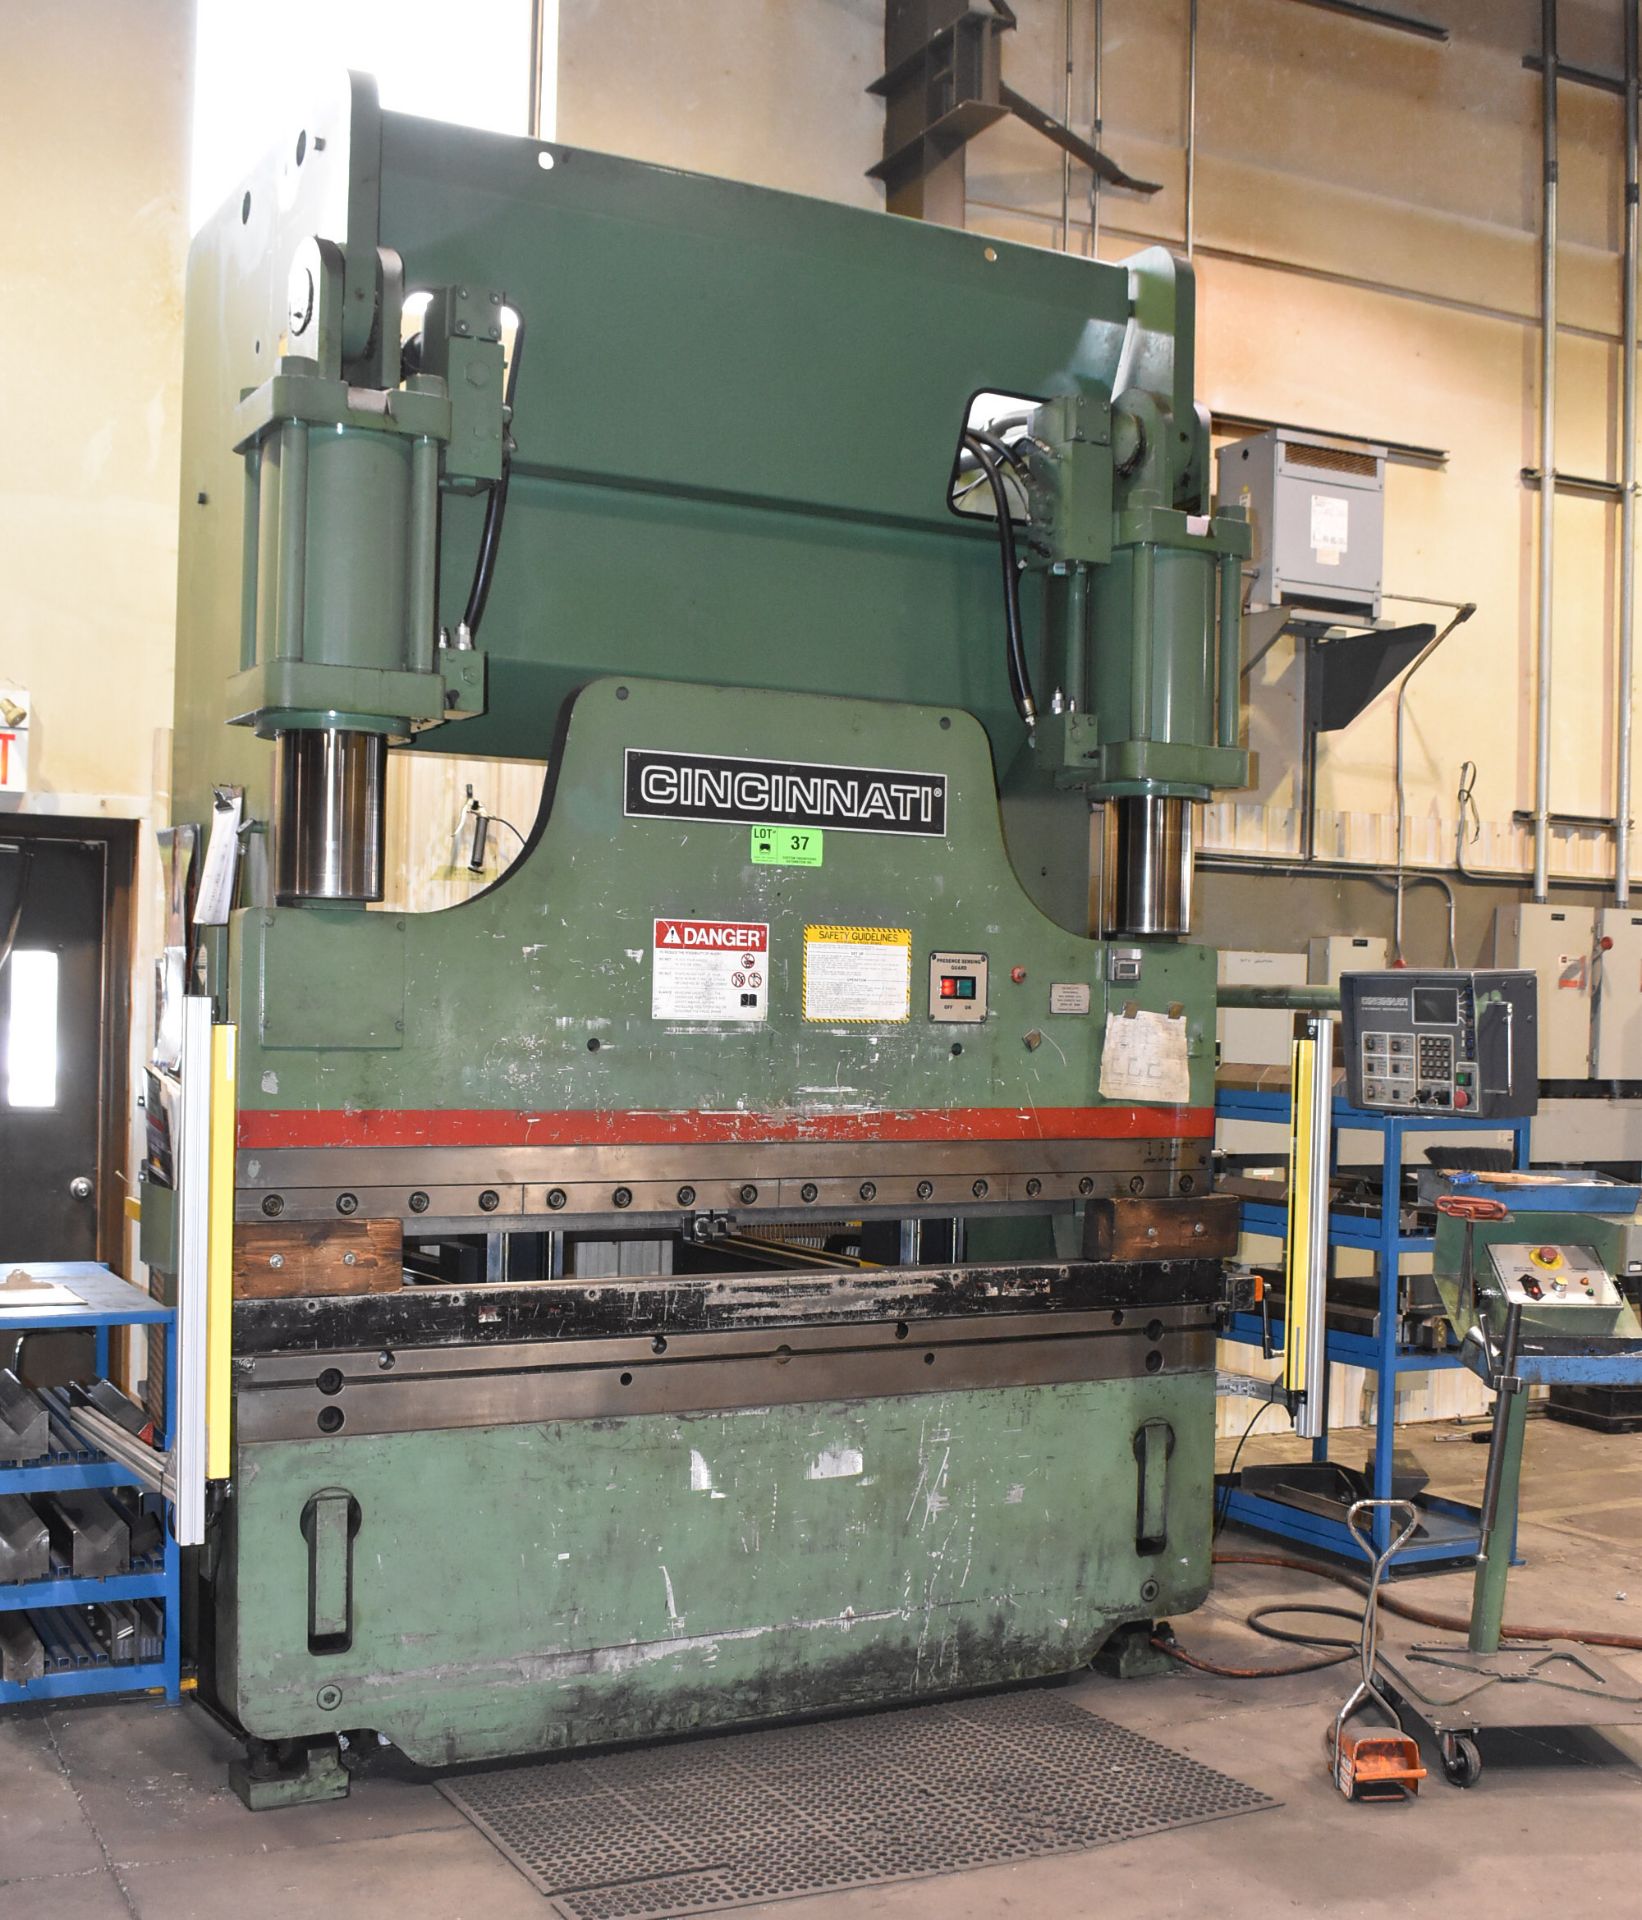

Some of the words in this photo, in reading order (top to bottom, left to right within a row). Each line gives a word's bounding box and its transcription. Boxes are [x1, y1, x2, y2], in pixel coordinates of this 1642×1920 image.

[791, 835, 810, 851] 37
[684, 927, 760, 947] DANGER
[818, 930, 850, 940] SAFETY
[851, 932, 898, 943] GUIDELINES
